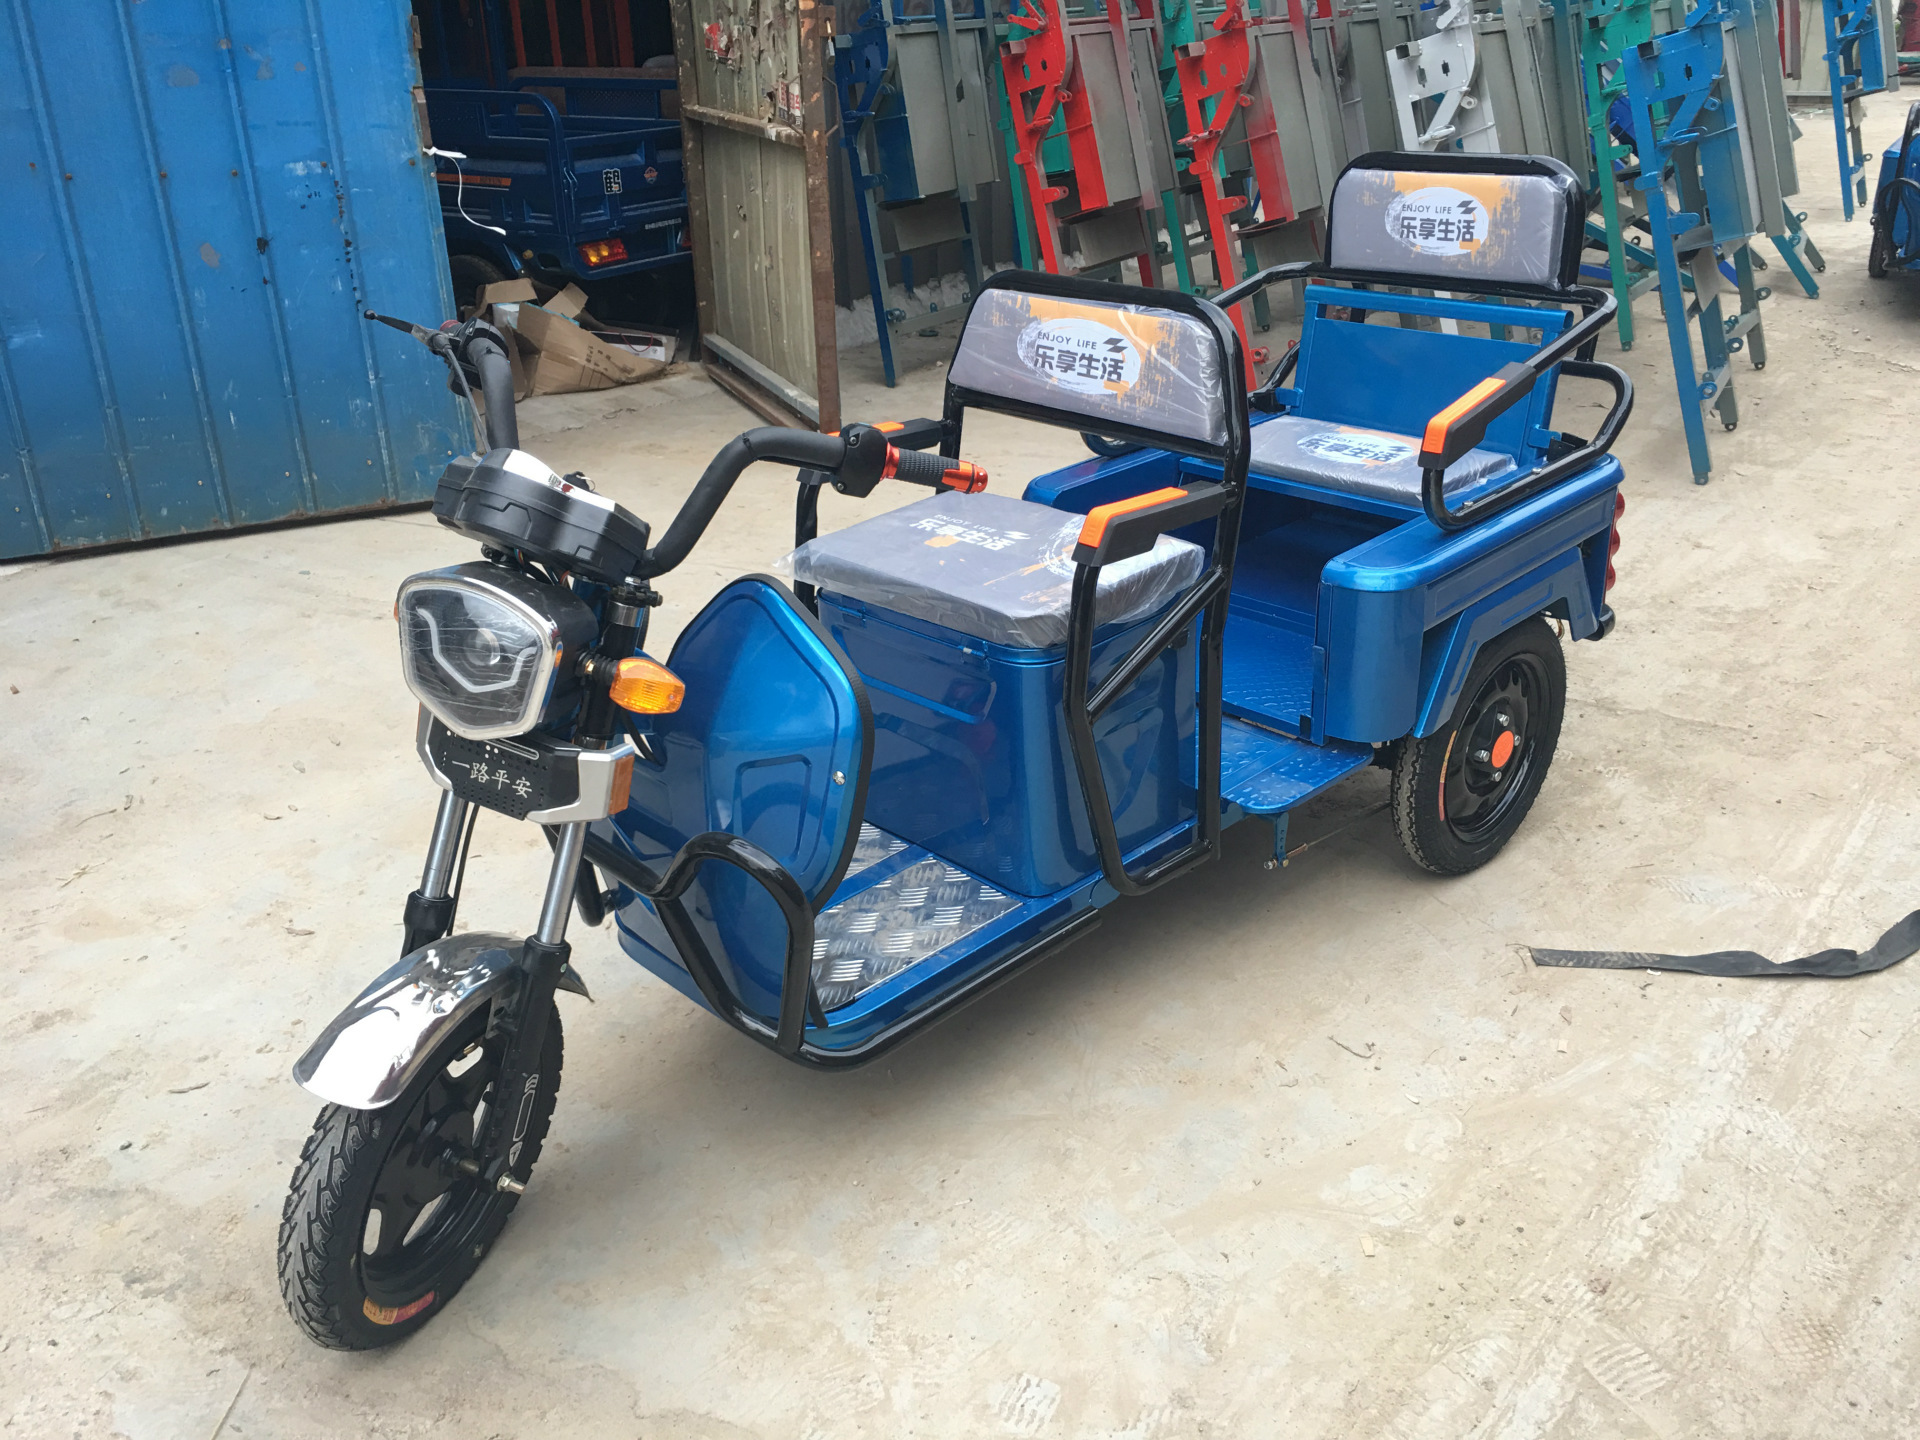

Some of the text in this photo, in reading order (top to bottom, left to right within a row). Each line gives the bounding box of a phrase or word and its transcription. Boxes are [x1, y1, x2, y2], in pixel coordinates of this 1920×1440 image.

[1402, 203, 1453, 214] ENJOY LIFE
[1399, 215, 1476, 242] 乐享生活
[1037, 331, 1098, 350] ENJOY LIFE
[1033, 344, 1125, 384] 乐享生活
[1298, 438, 1401, 462] 乐享生活
[908, 517, 1017, 551] 乐享生活
[933, 514, 998, 533] ENJOY LIFE
[451, 759, 533, 799] 一路平安
